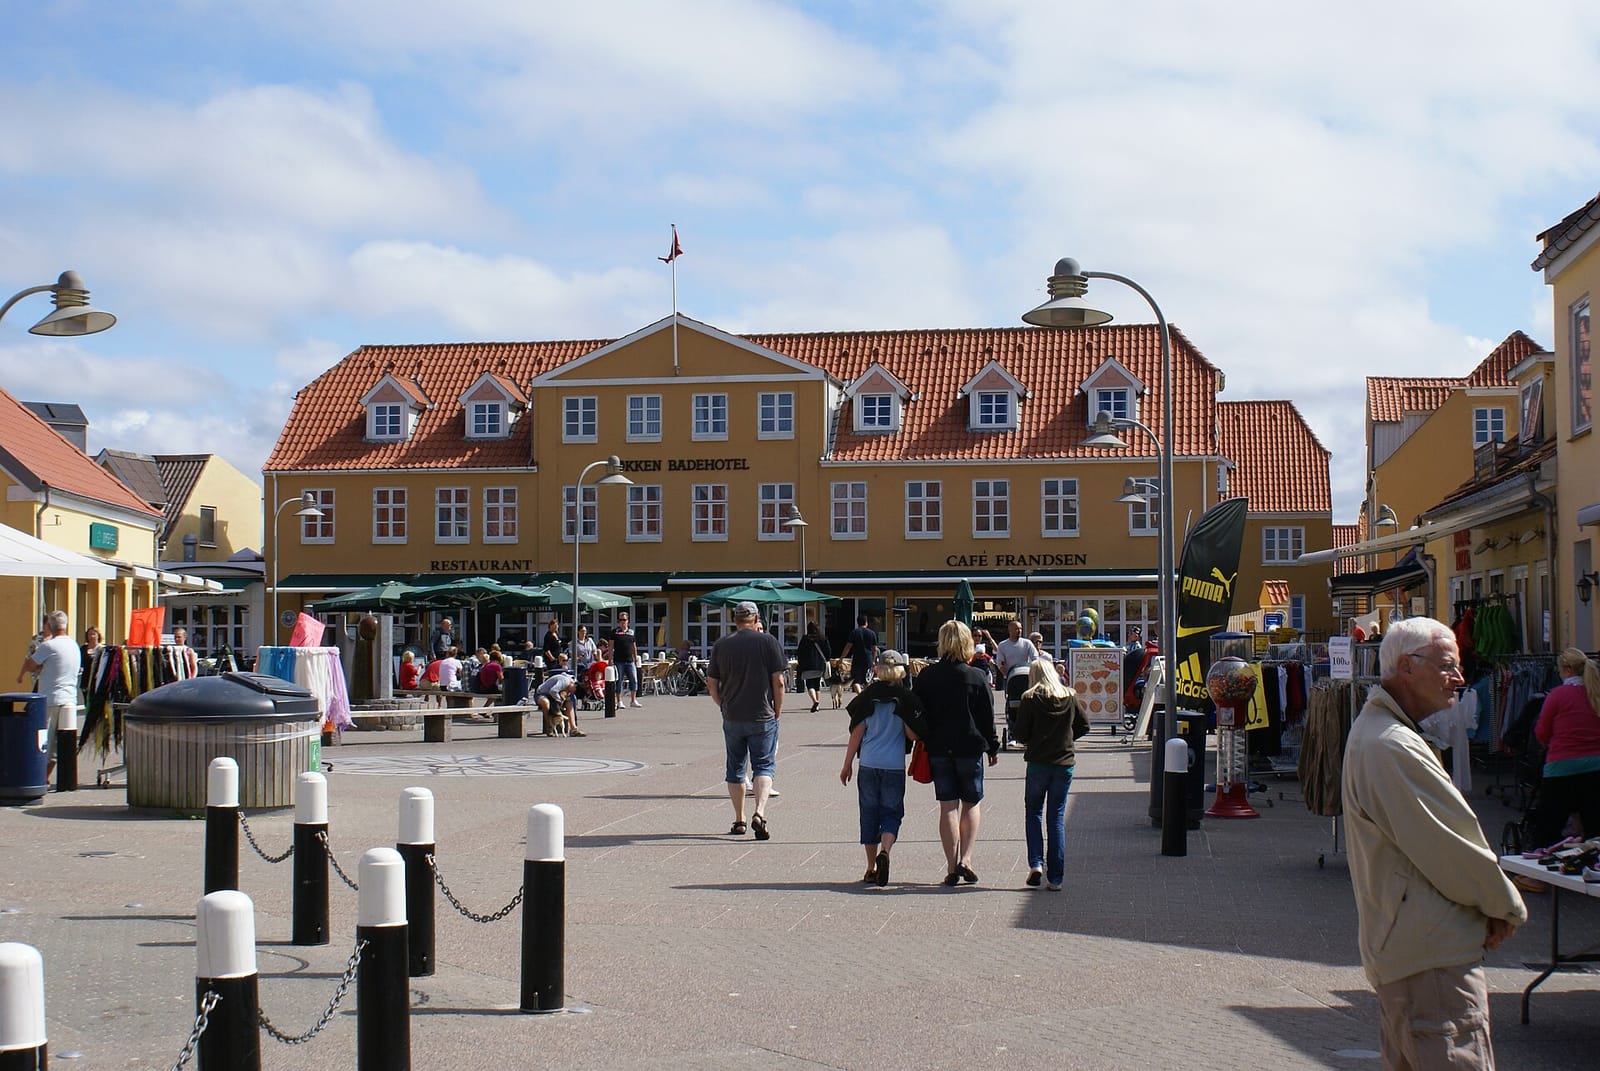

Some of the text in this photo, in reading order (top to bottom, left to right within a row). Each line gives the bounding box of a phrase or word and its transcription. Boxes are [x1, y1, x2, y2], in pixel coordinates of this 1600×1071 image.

[668, 458, 750, 471] BADEHOTEL
[430, 560, 533, 571] RESTAURANT
[946, 550, 1087, 567] CAFÉ FRANDSEN
[1182, 576, 1224, 603] PUMA
[1176, 677, 1208, 699] didas
